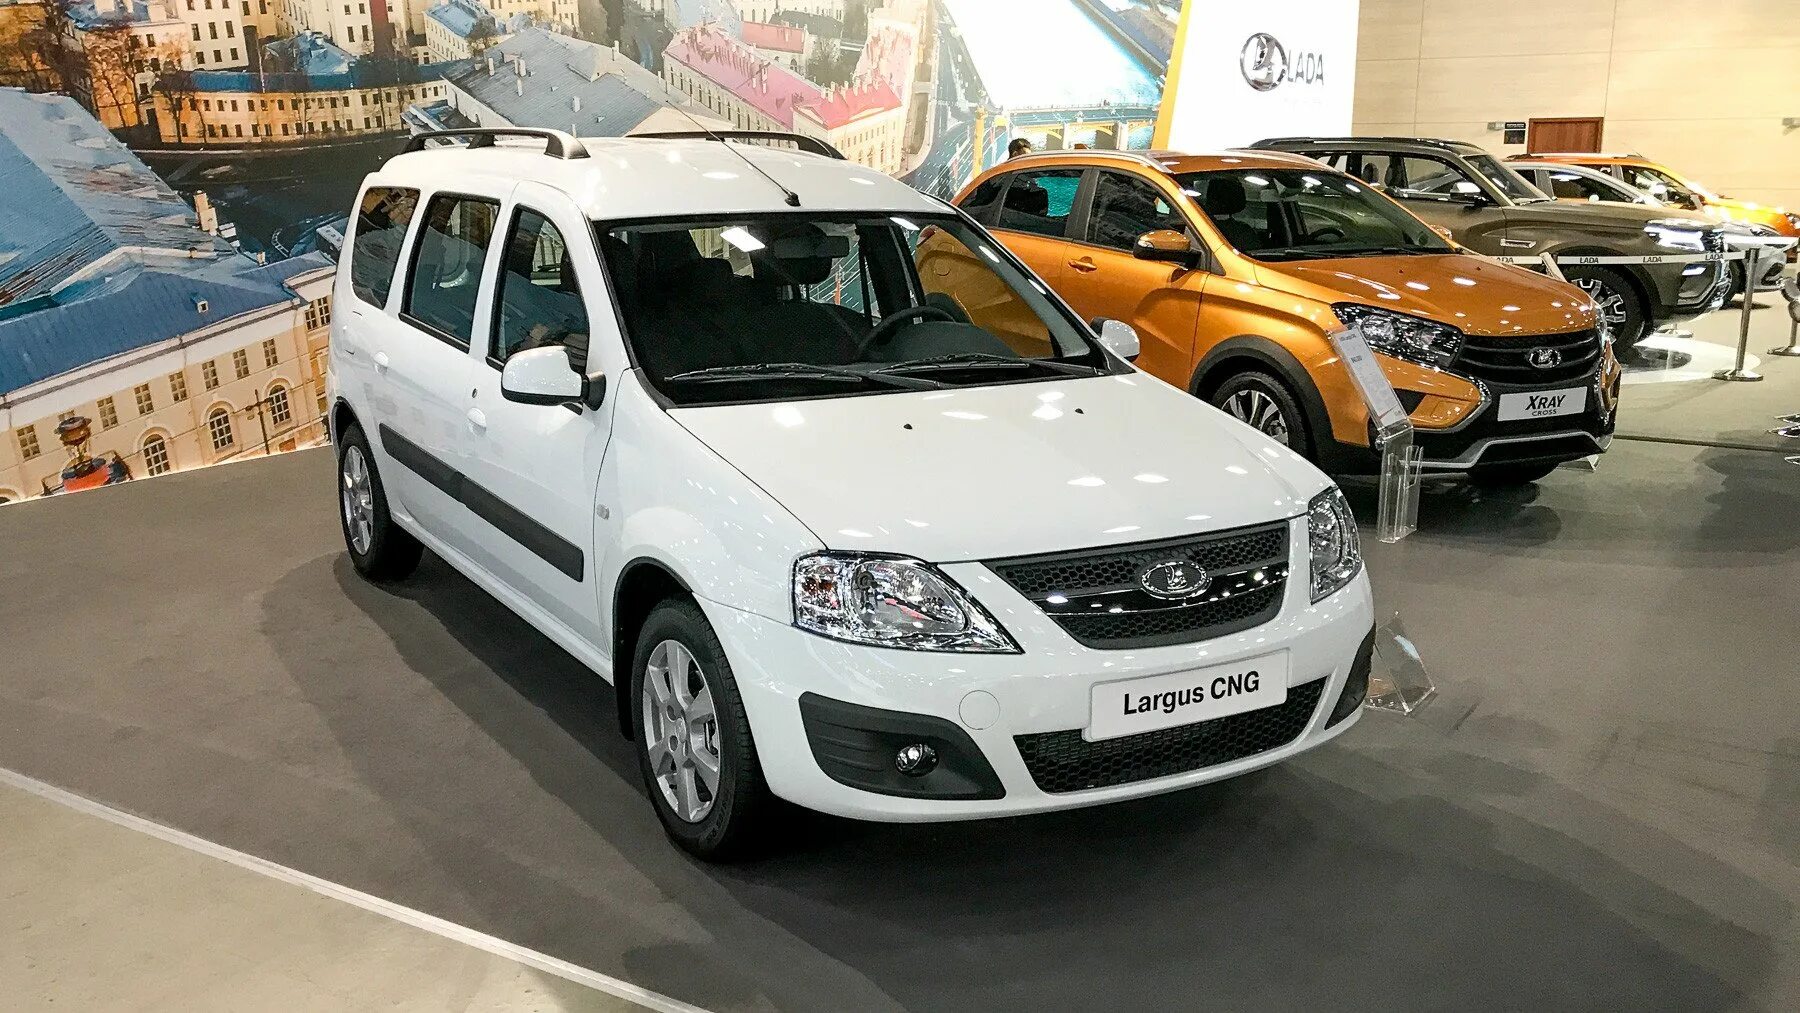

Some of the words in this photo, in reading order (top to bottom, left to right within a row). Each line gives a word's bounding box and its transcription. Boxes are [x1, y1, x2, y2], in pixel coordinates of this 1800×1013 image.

[1286, 49, 1325, 86] LADA
[1705, 253, 1724, 261] LADA
[1525, 394, 1566, 410] XRAY
[1531, 408, 1557, 417] CROSS
[1123, 686, 1204, 714] Largus
[1210, 670, 1260, 700] CNG
